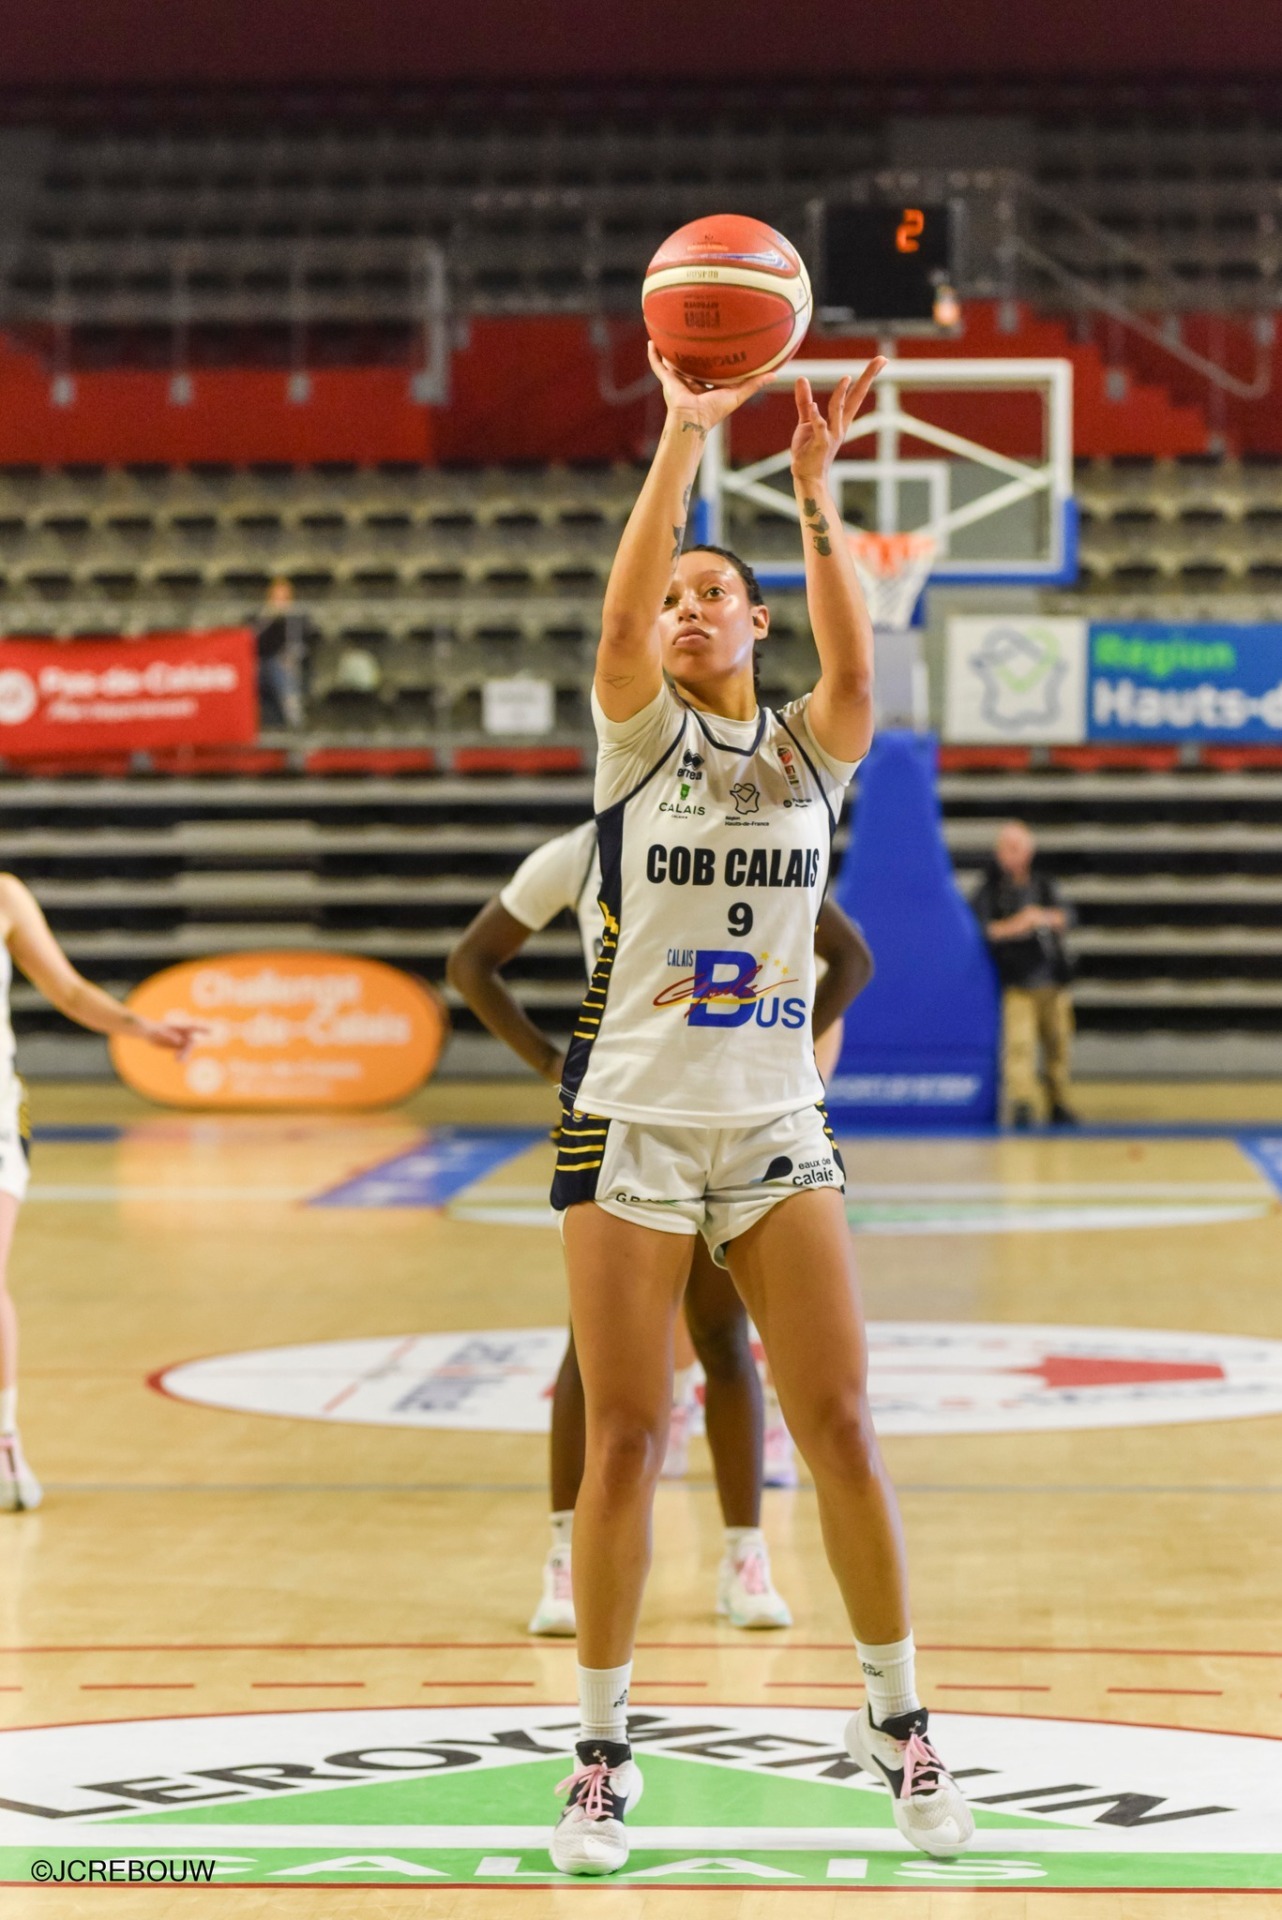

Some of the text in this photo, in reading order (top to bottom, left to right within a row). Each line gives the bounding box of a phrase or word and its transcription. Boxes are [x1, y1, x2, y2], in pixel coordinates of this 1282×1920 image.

[896, 209, 924, 253] 2
[658, 801, 706, 816] CALAIS
[646, 844, 820, 888] COB CALAIS
[727, 902, 754, 938] 9
[667, 949, 694, 967] CALAIS
[799, 1160, 820, 1169] eaux
[792, 1167, 834, 1186] calais
